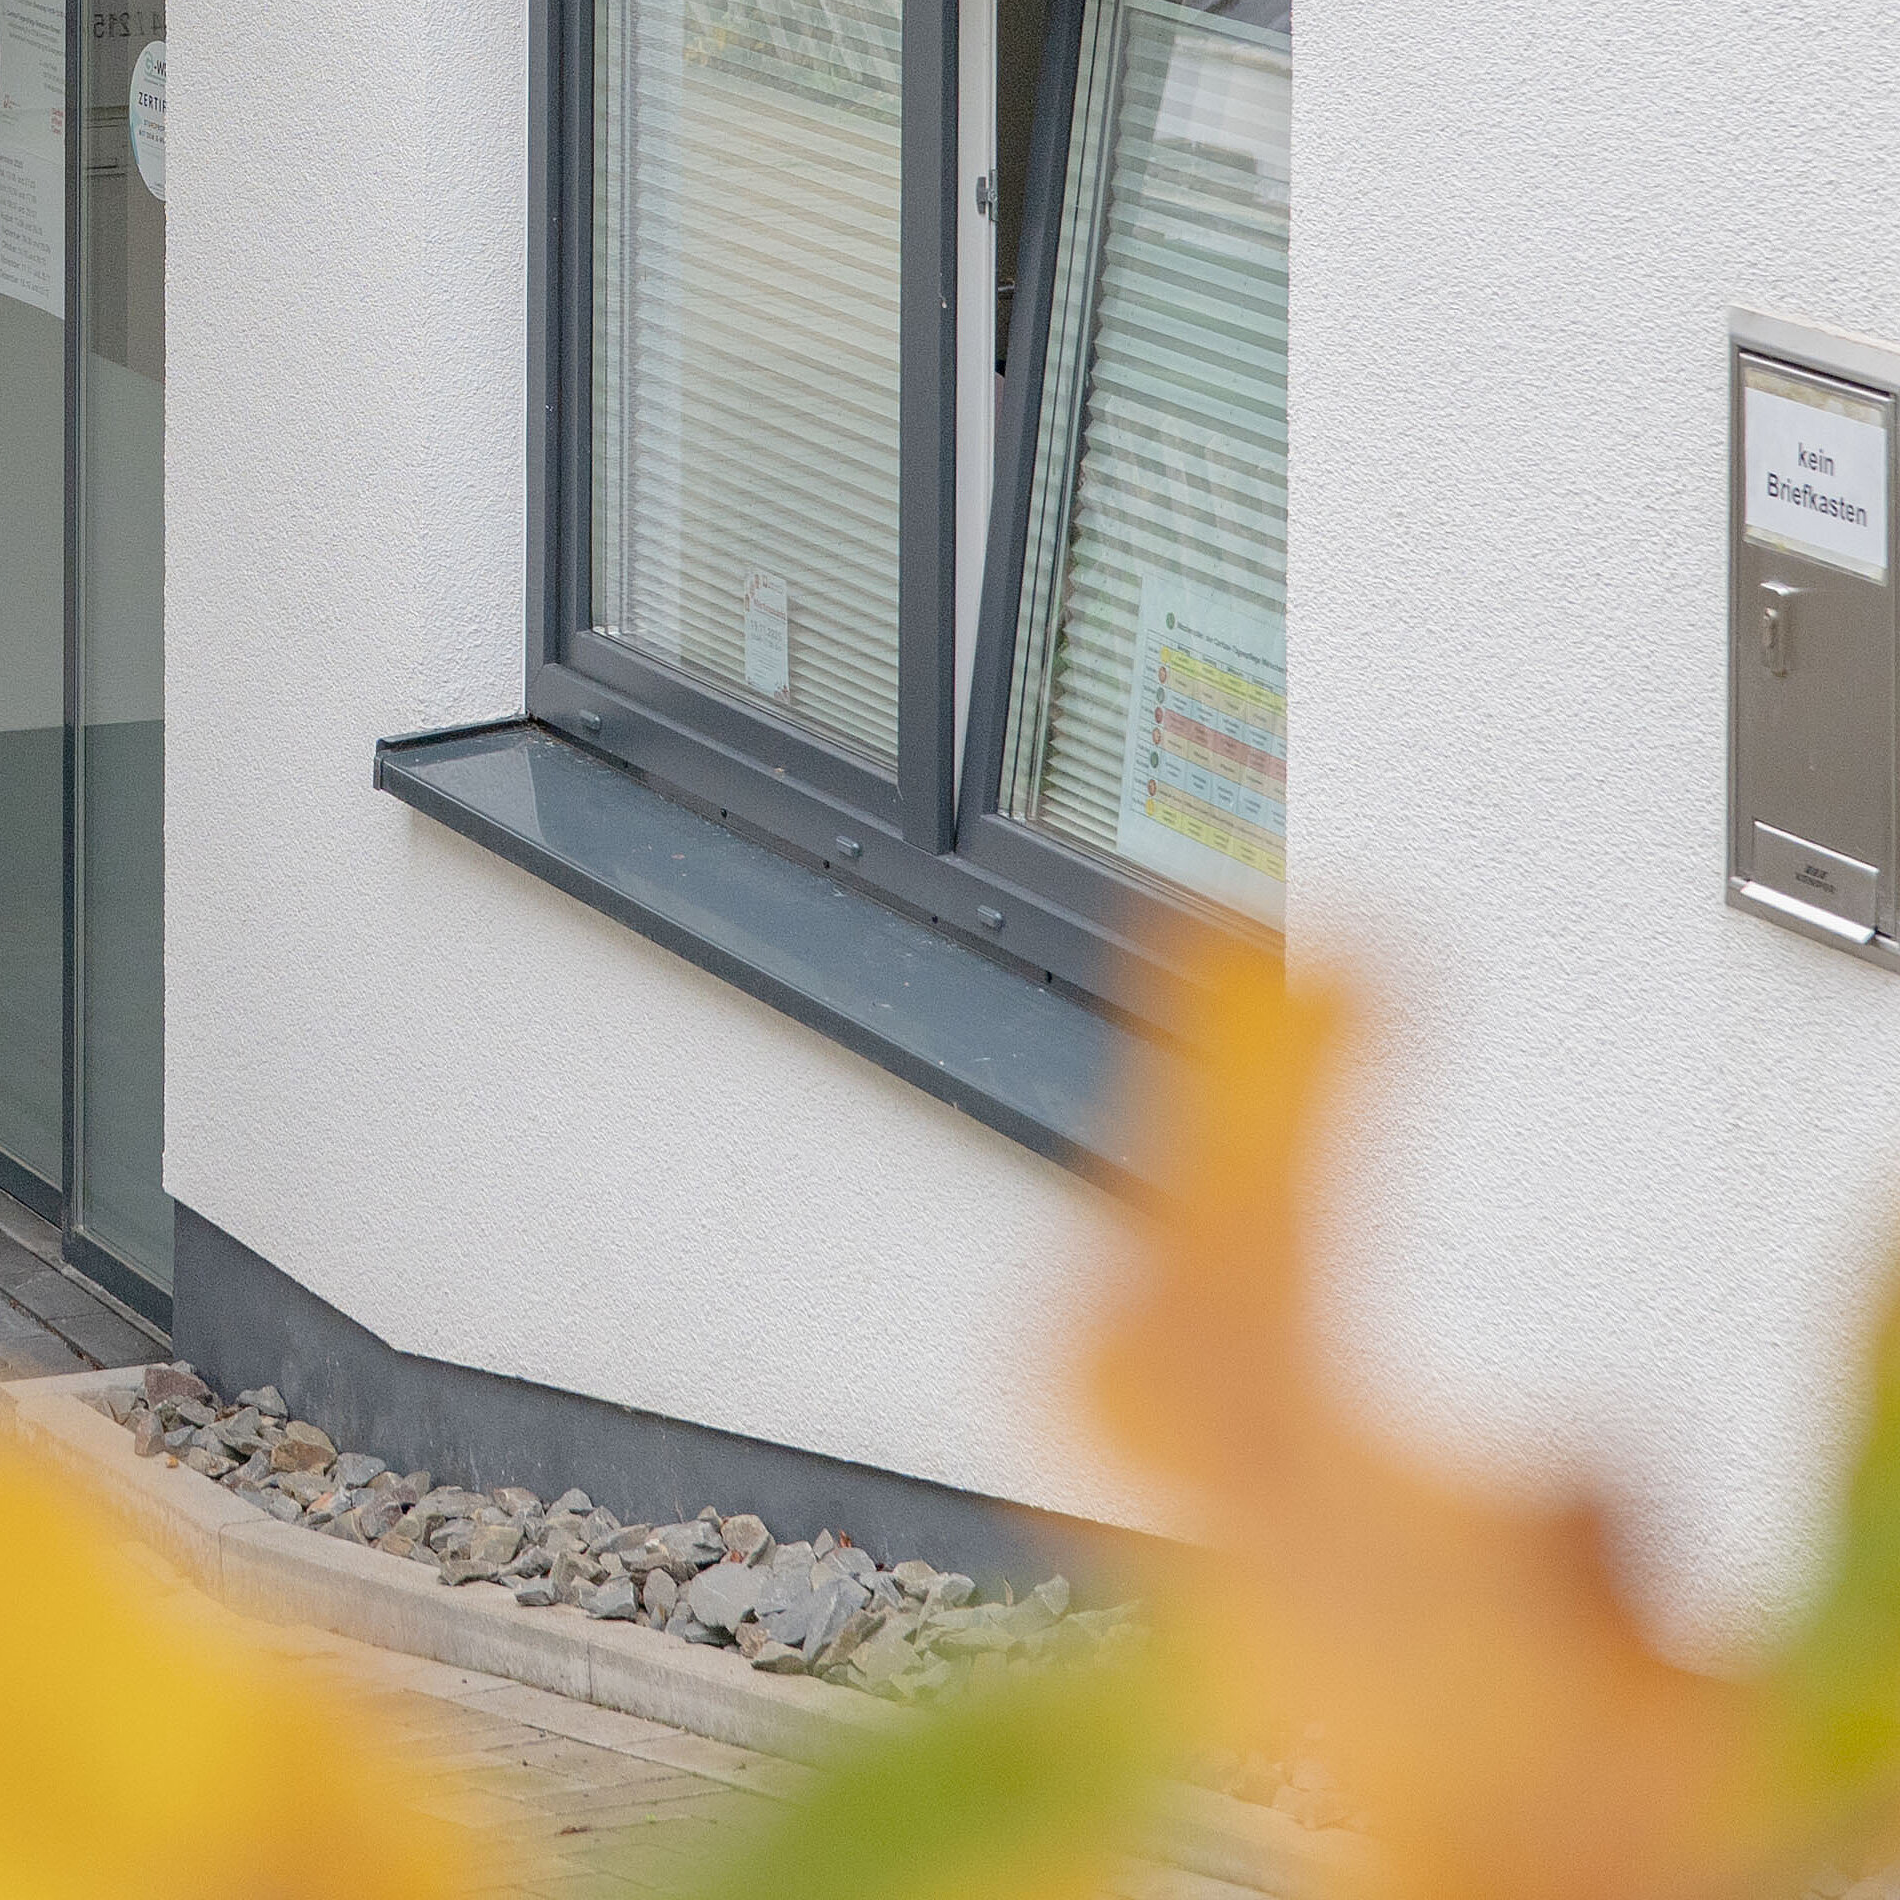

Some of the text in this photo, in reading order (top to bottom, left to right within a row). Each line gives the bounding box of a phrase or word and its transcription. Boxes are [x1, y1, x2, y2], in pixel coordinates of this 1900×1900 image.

[138, 91, 167, 114] ZERTIF
[1797, 441, 1834, 477] kein
[1767, 471, 1868, 527] Briefkasten
